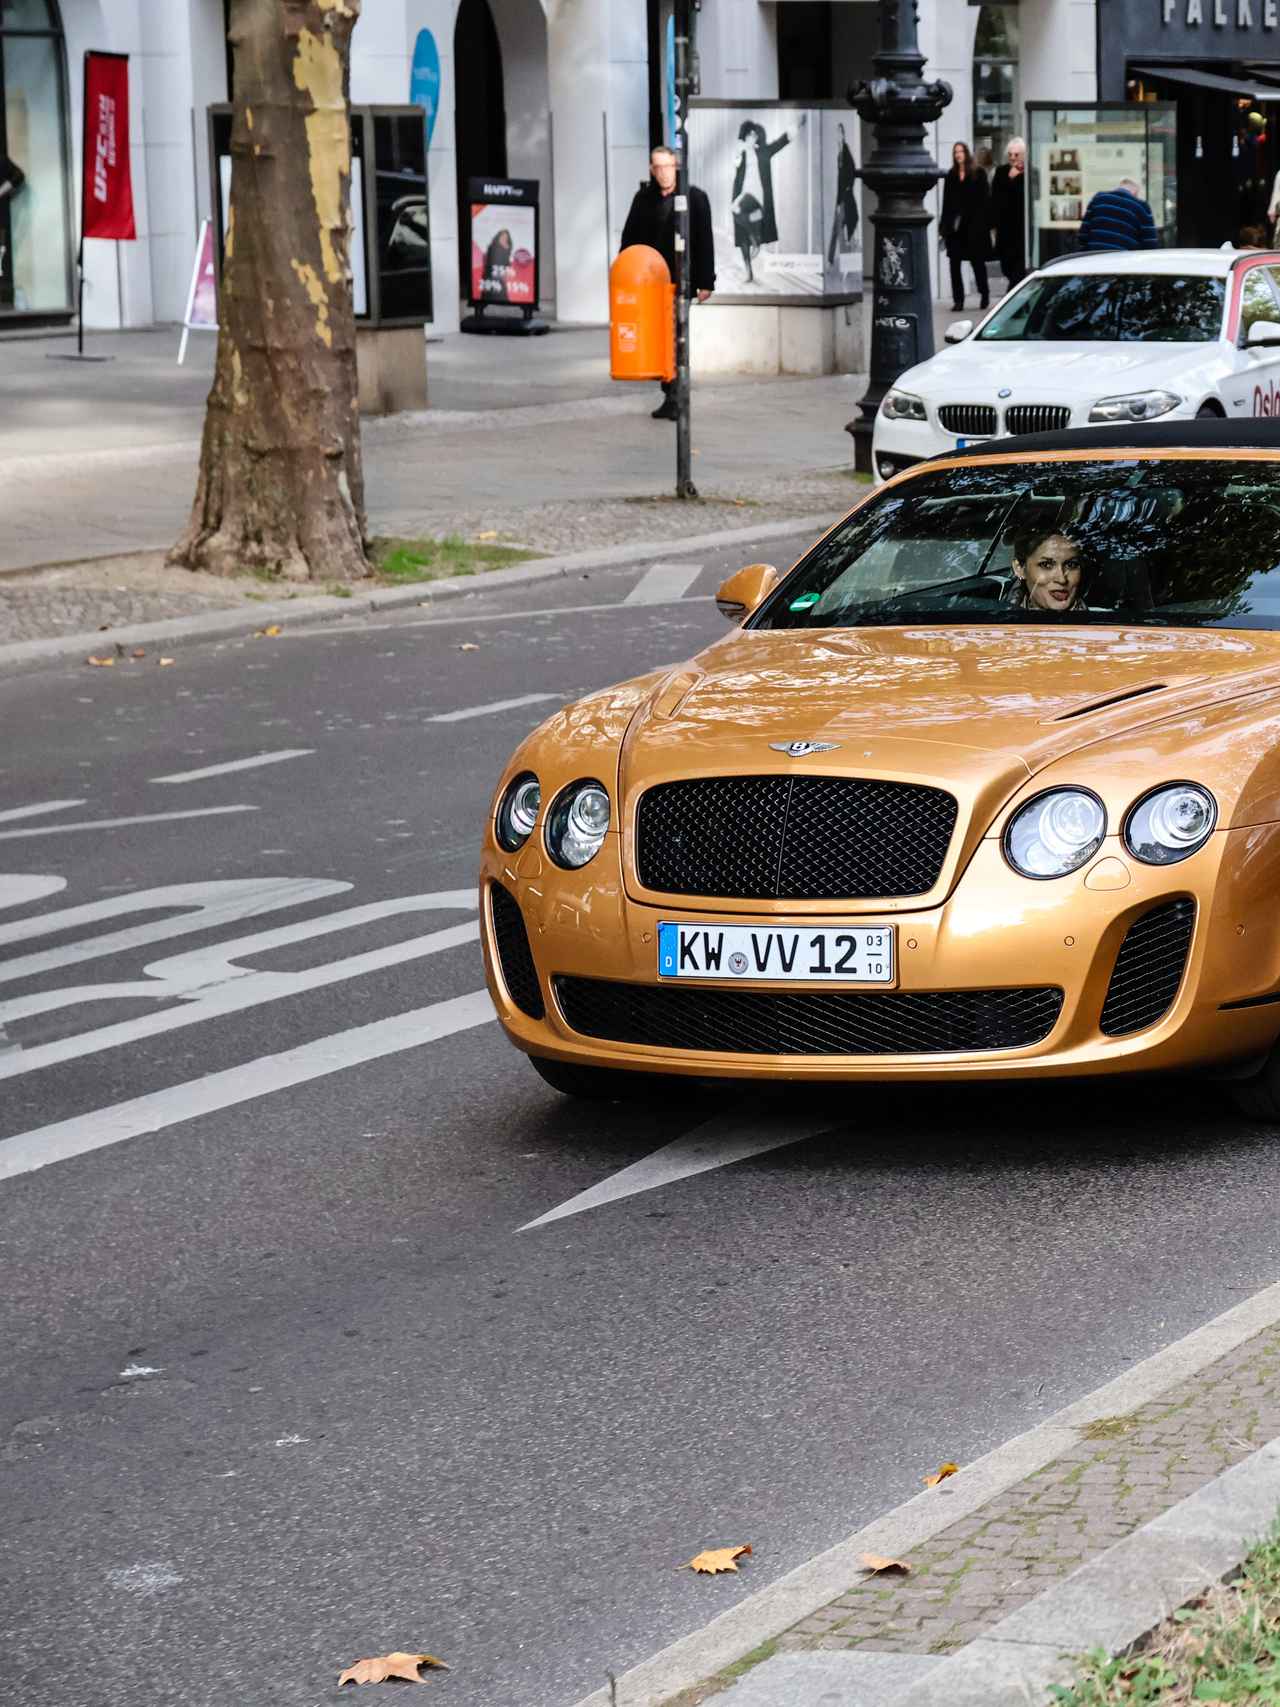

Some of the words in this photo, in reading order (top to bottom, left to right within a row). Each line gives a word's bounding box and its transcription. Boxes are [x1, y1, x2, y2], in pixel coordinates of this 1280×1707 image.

[1163, 0, 1278, 26] FALKE
[94, 133, 107, 202] UFC
[492, 264, 516, 277] 25%
[478, 279, 502, 292] 20%
[506, 281, 529, 293] 15%
[866, 935, 883, 946] 03
[665, 956, 673, 968] D
[679, 931, 724, 971] KW
[751, 933, 800, 973] VV
[809, 934, 858, 974] 12
[867, 962, 883, 974] 10
